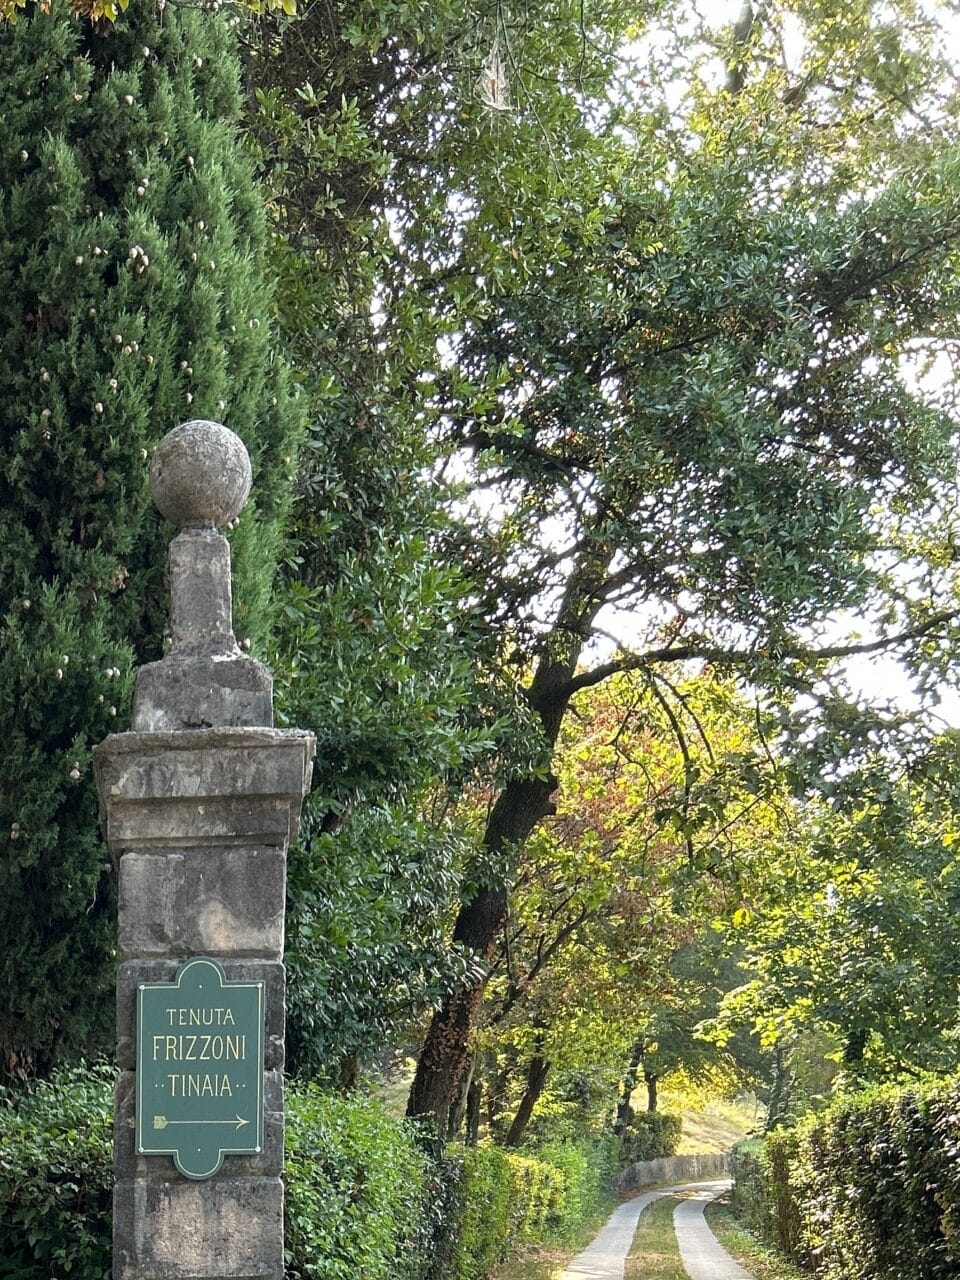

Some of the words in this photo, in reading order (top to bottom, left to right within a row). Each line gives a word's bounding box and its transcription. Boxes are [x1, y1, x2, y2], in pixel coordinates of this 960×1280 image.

[166, 1008, 235, 1026] TENUTA
[152, 1034, 246, 1061] FRIZZONI
[167, 1073, 233, 1097] TINAIA
